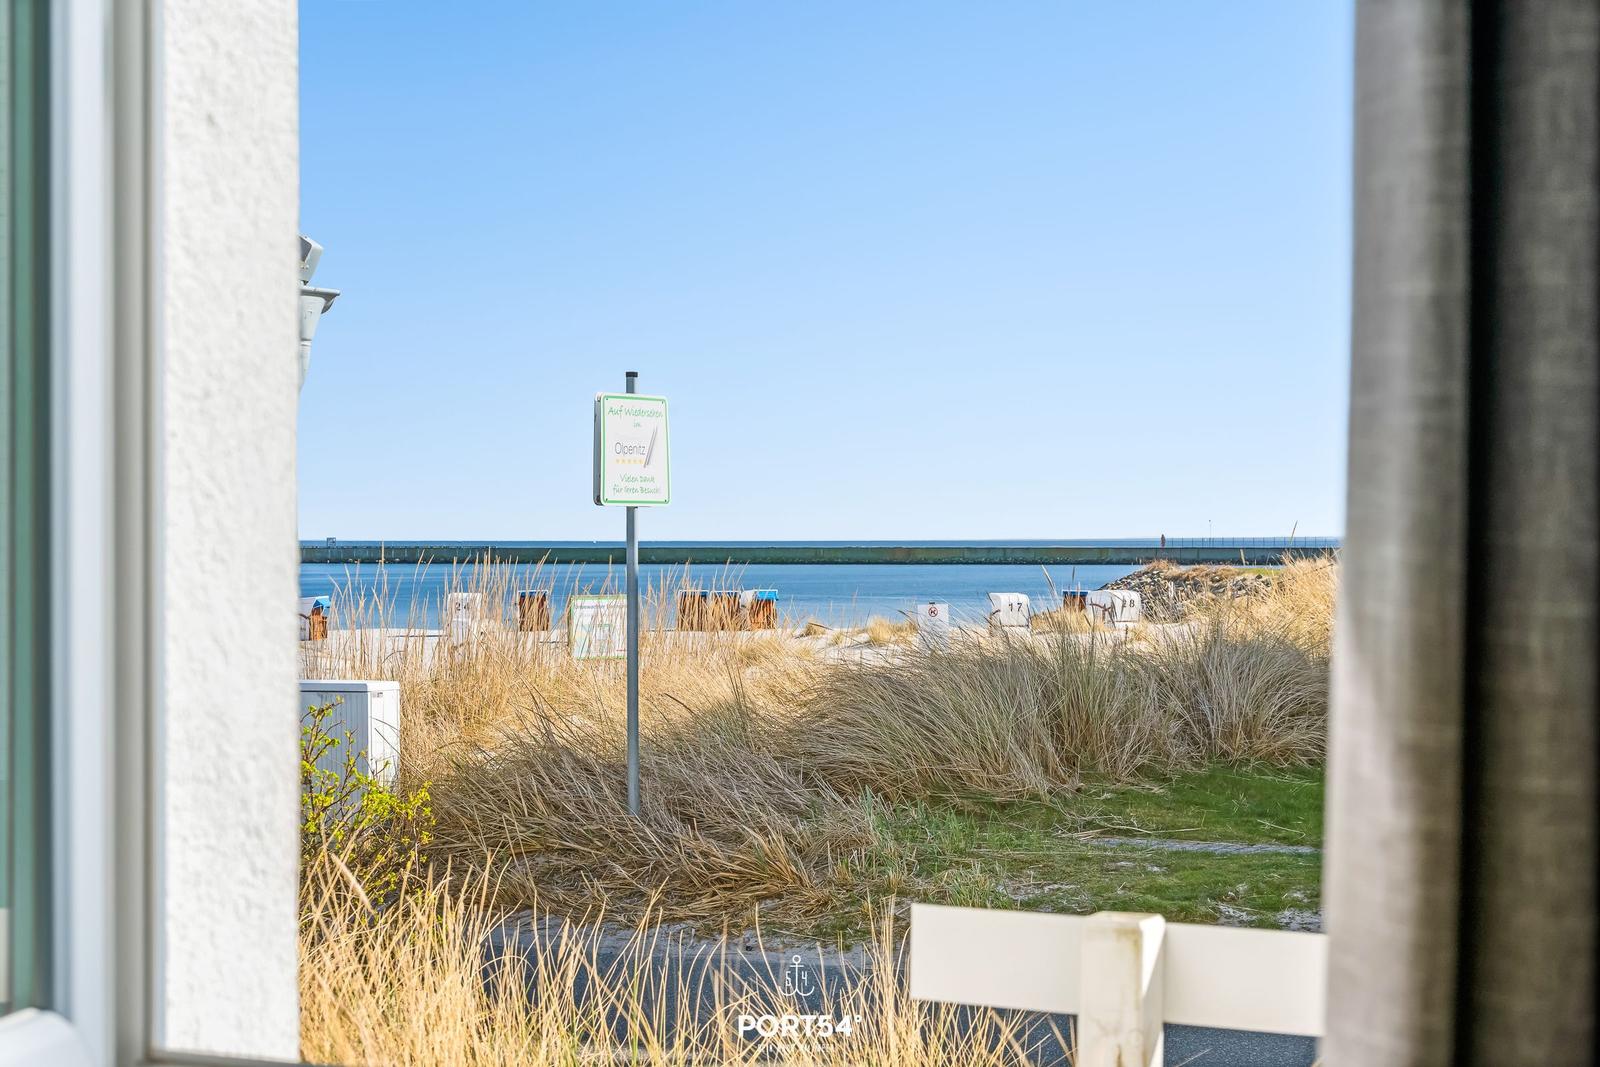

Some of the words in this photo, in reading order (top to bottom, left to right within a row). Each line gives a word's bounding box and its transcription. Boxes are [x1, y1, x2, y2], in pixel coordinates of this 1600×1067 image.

[607, 404, 623, 420] Auf
[614, 441, 646, 456] Olpenitz
[1008, 601, 1022, 612] 17
